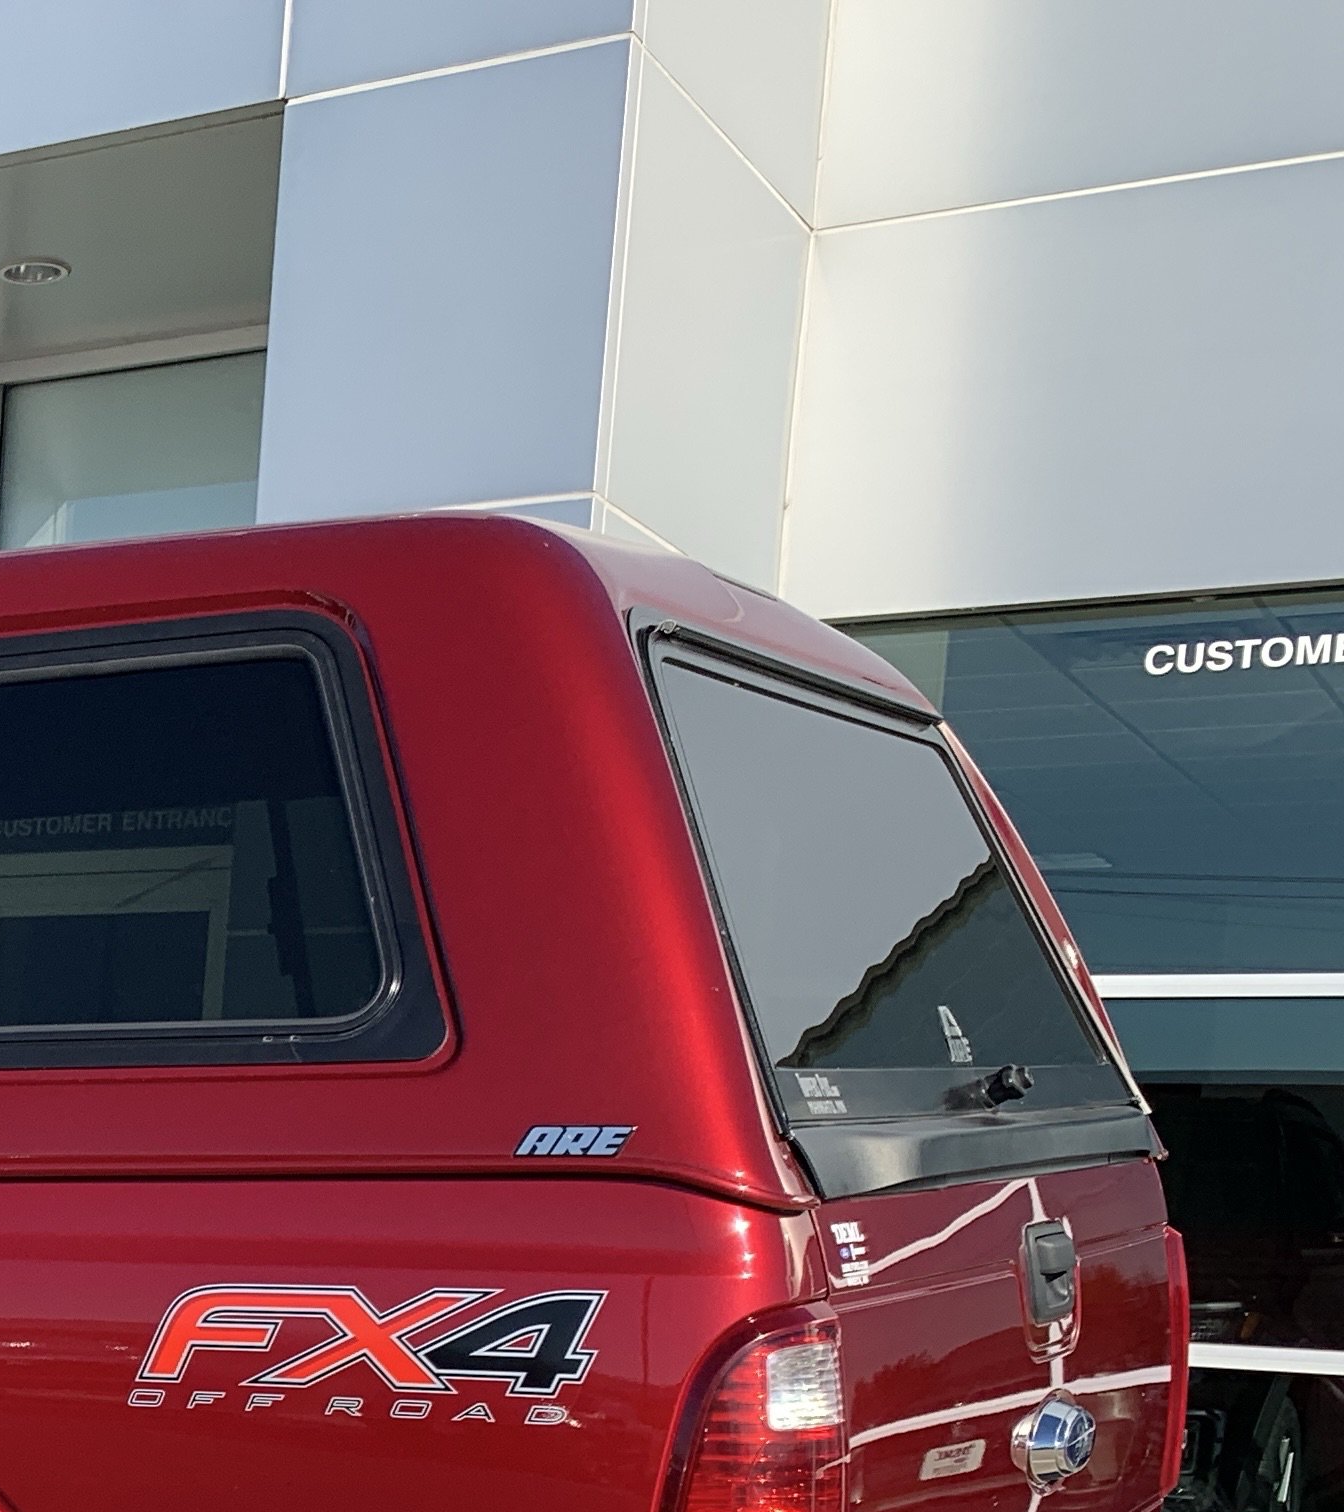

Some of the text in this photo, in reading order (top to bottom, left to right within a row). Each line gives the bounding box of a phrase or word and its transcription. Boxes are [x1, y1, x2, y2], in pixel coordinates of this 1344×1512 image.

[514, 1125, 636, 1157] ARE
[135, 1284, 609, 1398] FX4
[127, 1388, 570, 1427] OFF ROAD
